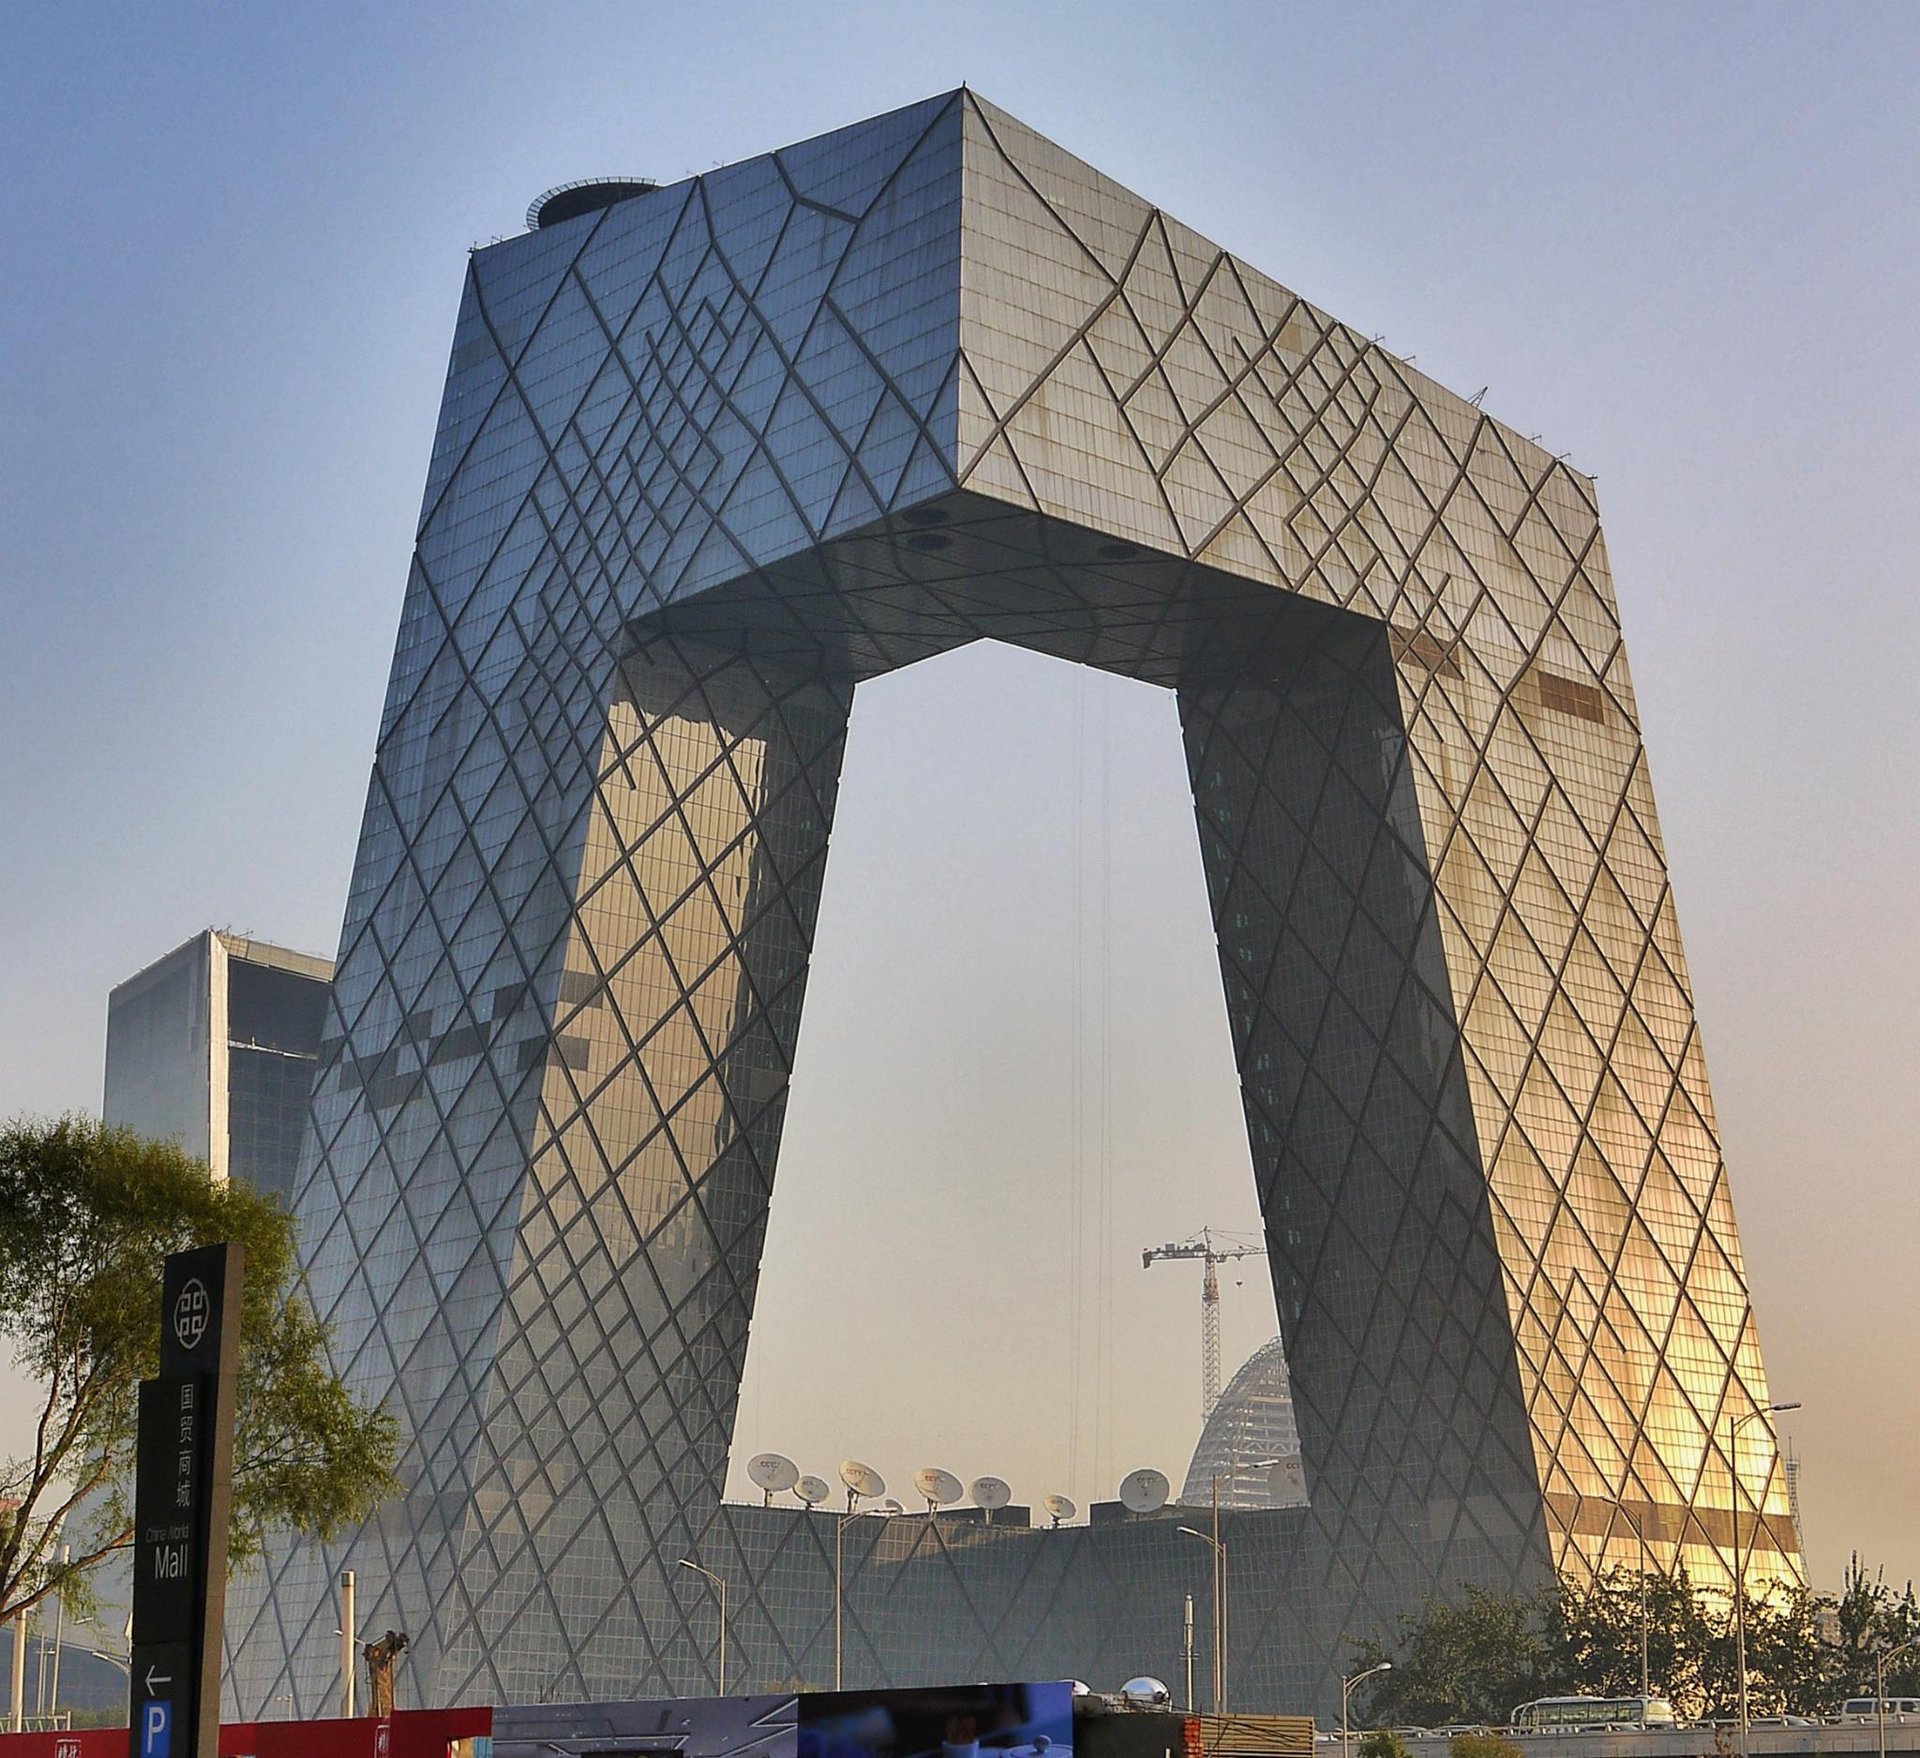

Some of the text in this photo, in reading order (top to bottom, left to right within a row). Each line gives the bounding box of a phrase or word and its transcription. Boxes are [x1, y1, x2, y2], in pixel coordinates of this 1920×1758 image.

[177, 1384, 193, 1507] 国贸商城
[155, 1543, 188, 1579] Mall
[147, 1706, 165, 1754] P
